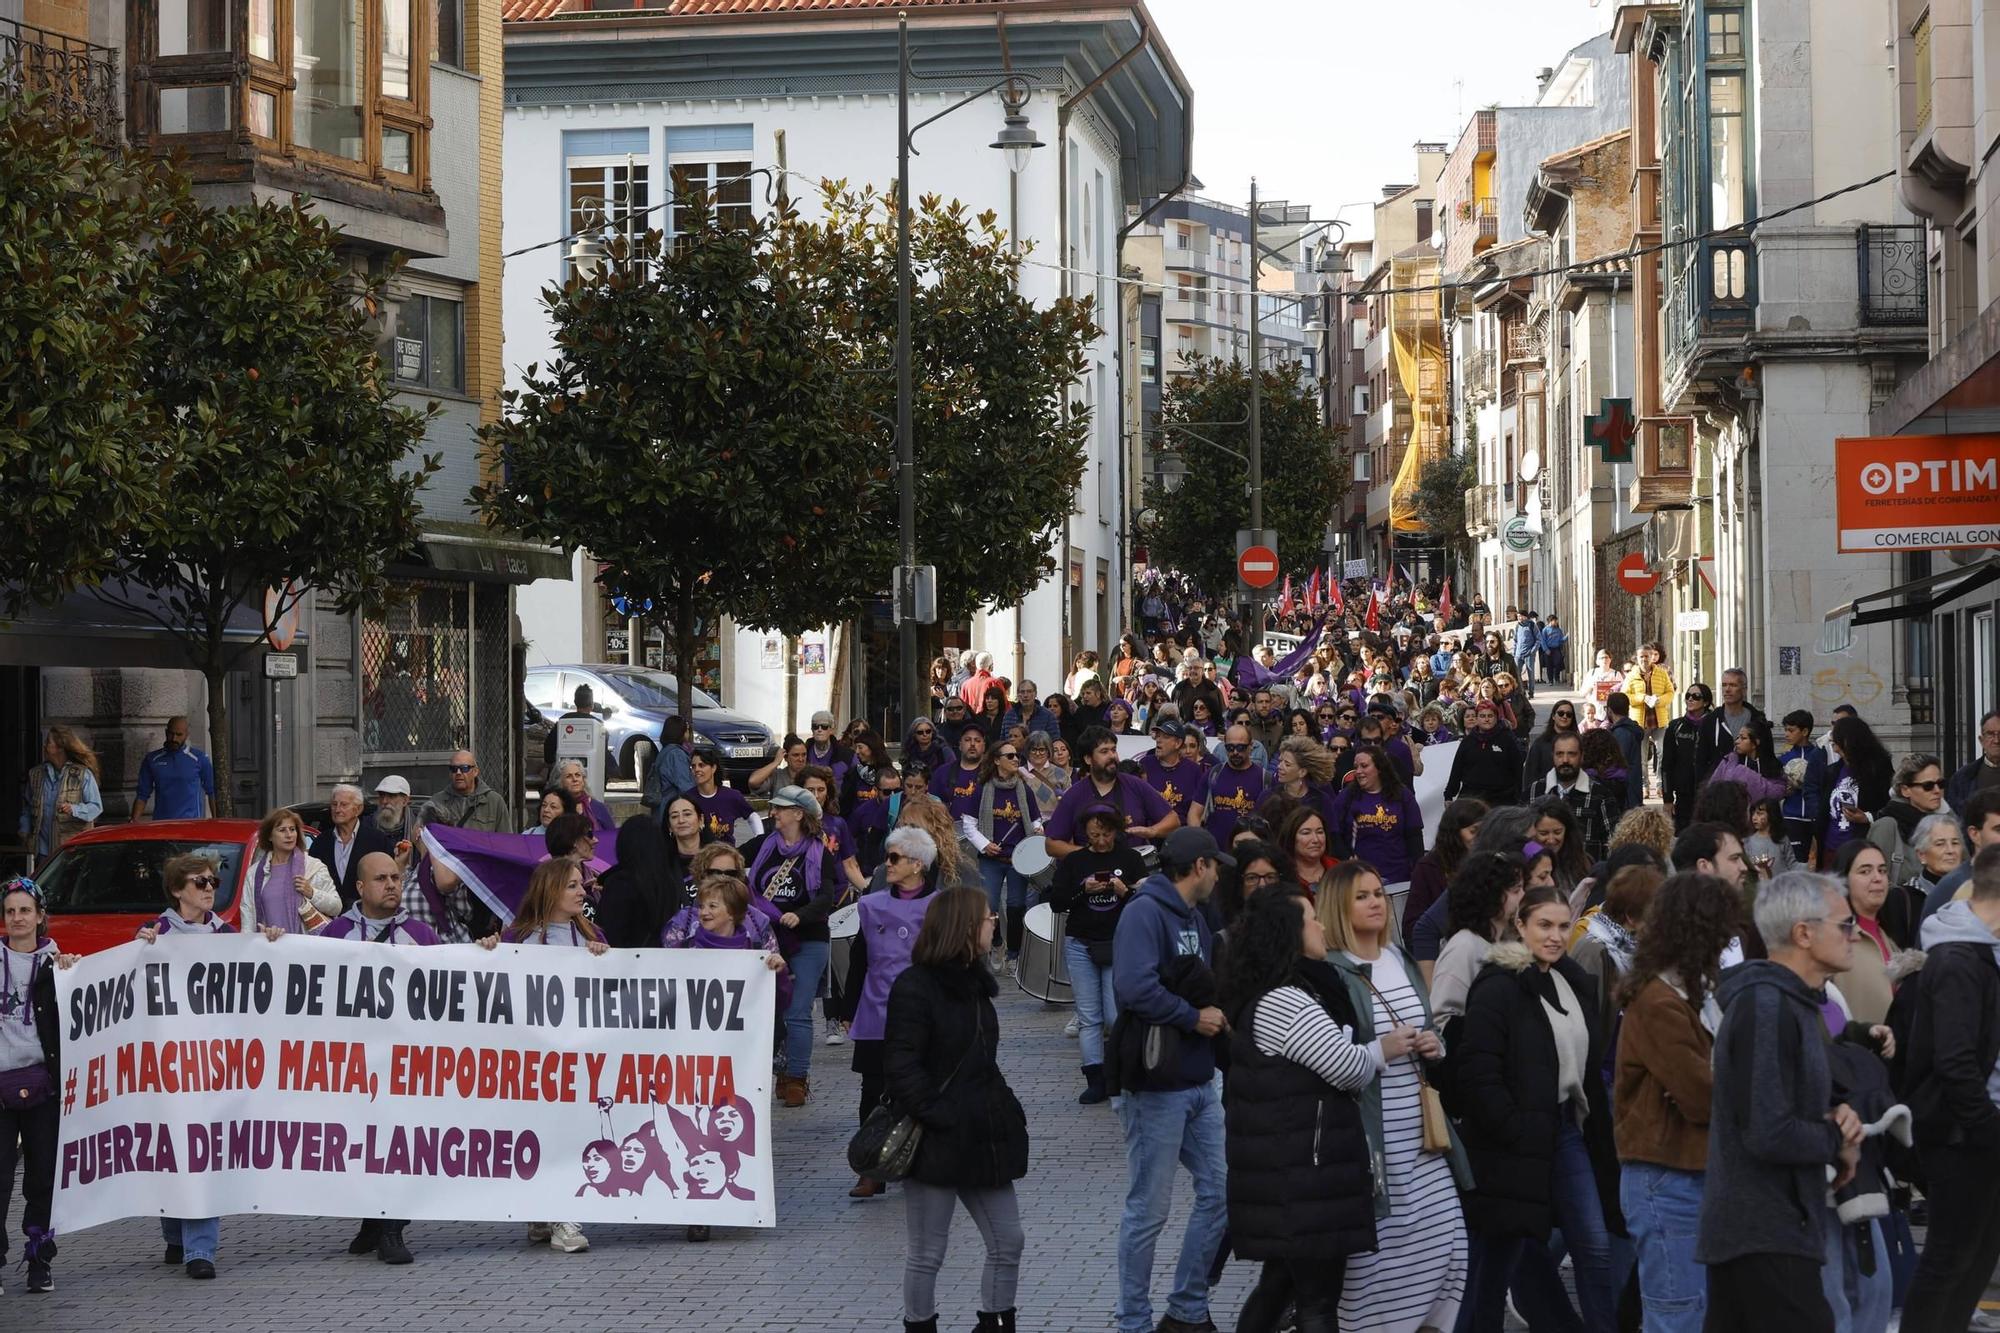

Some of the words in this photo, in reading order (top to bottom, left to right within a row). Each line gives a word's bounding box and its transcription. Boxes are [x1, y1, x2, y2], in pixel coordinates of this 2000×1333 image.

[1860, 458, 1998, 495] OPTIM
[1865, 496, 1923, 508] FERRETERÍAS
[1924, 496, 1937, 505] DE
[1938, 494, 1991, 505] CONFIANZA
[1874, 531, 1963, 546] COMERCIAL
[70, 969, 137, 1042] SOMOS
[146, 963, 179, 1016] EL
[187, 962, 274, 1015] GRITO
[286, 963, 326, 1016] DE
[337, 965, 395, 1020] LAS
[407, 967, 467, 1024] QUE
[474, 971, 514, 1025] YA
[527, 974, 565, 1028] NO
[575, 977, 677, 1030] TIENEN
[687, 979, 746, 1032] VOZ
[64, 1067, 78, 1117] #
[86, 1055, 109, 1109] EL
[117, 1038, 265, 1096] MACHISMO
[278, 1040, 378, 1103] MATA,
[390, 1045, 579, 1103] EMPOBRECE
[585, 1053, 609, 1104] Y
[615, 1053, 736, 1106] ATONTA
[61, 1122, 179, 1190] FUERZA
[188, 1122, 223, 1173] DE
[229, 1120, 541, 1181] MUYER-LANGREO
